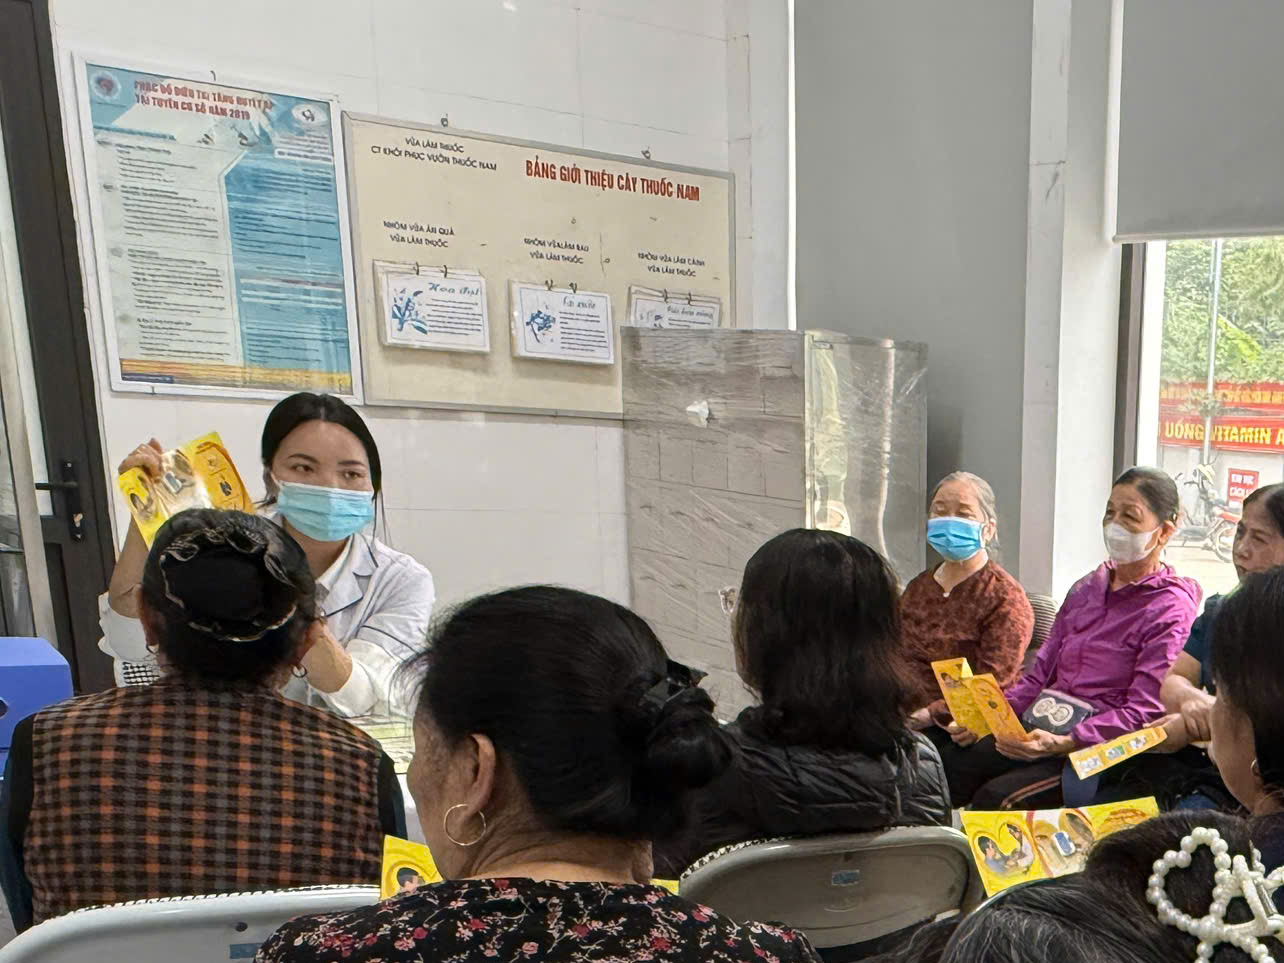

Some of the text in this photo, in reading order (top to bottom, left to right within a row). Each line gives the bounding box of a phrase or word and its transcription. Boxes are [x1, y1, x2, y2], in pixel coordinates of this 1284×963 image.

[229, 109, 250, 120] 2019
[526, 155, 700, 201] BẢNG GIỚI THIỆU CÂY THUỐC NAM
[1165, 418, 1204, 440] UỐNG
